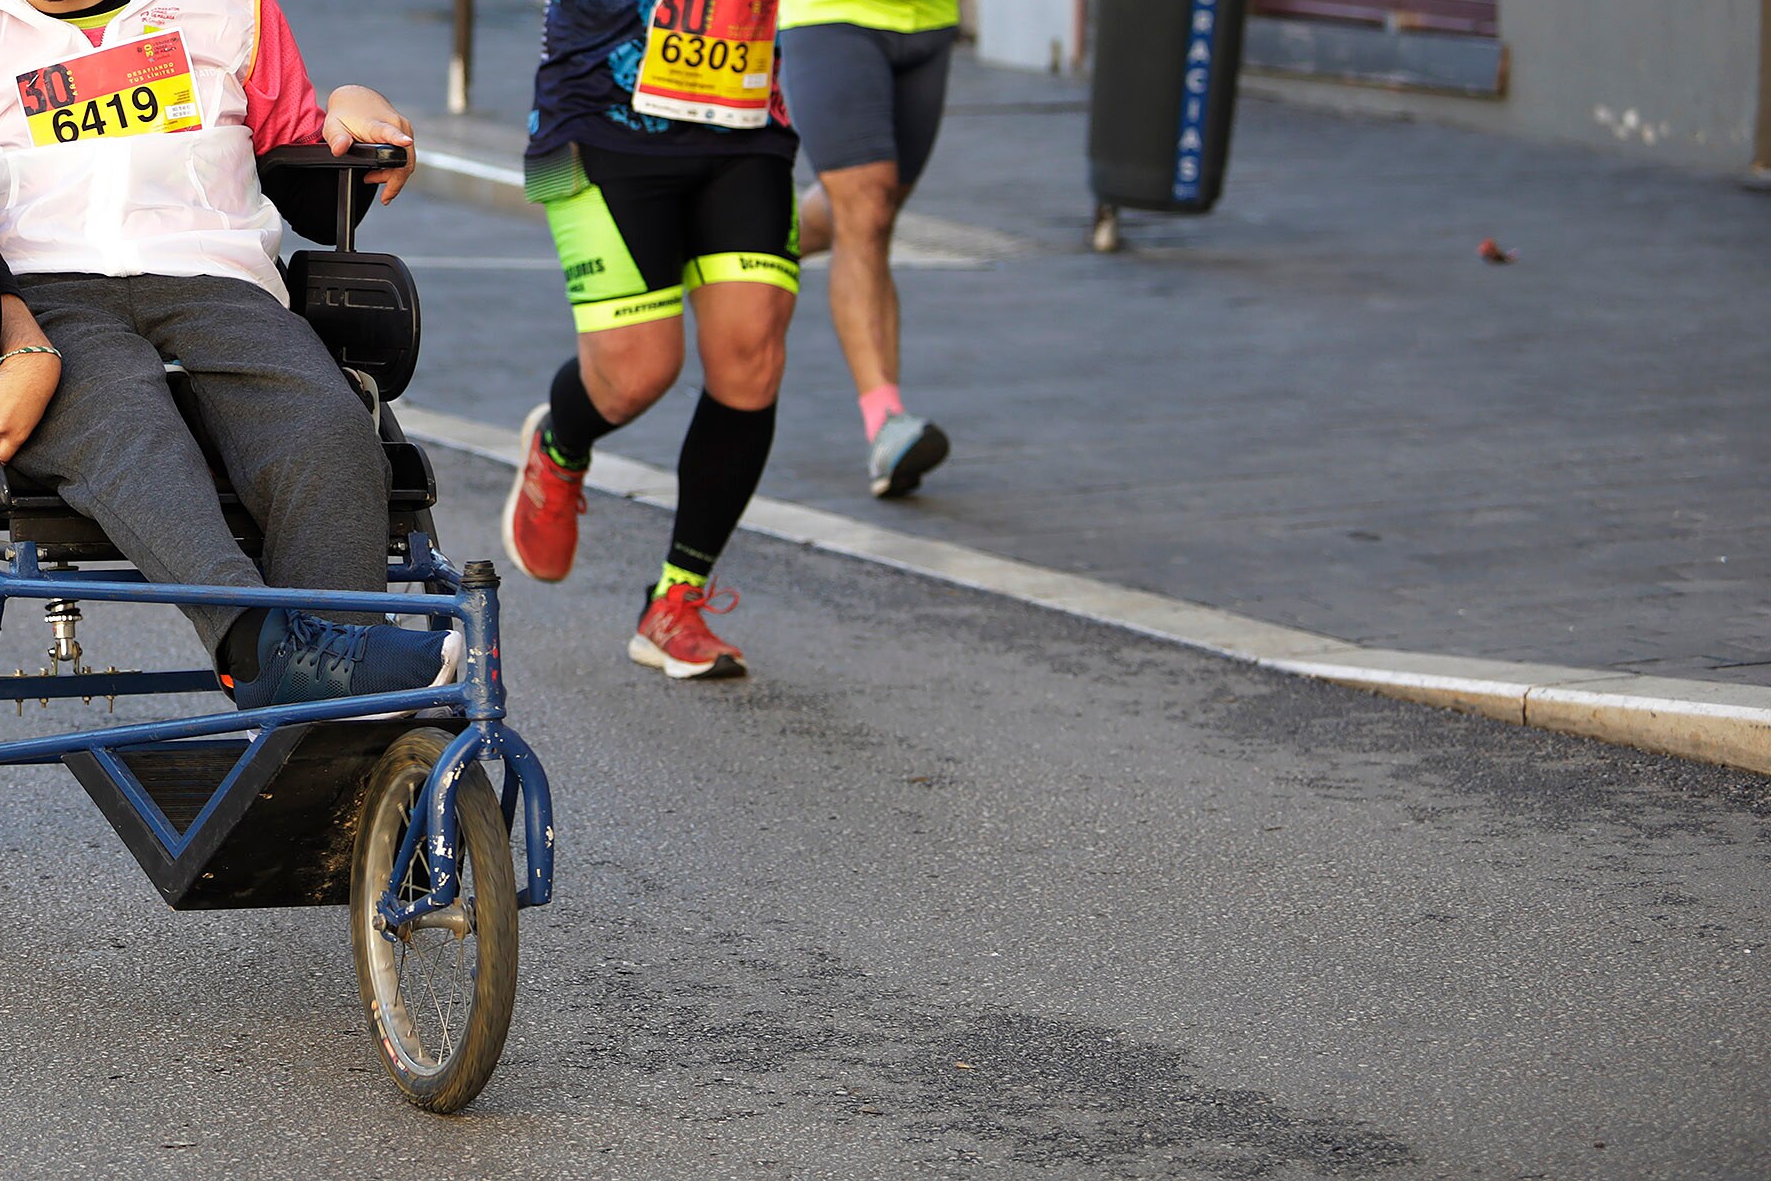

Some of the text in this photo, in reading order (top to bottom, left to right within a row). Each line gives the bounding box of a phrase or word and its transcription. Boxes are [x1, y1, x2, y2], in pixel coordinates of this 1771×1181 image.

[661, 33, 749, 74] 6303
[126, 61, 175, 79] DESAFIANDO
[128, 75, 145, 84] TUS
[51, 85, 159, 144] 6419
